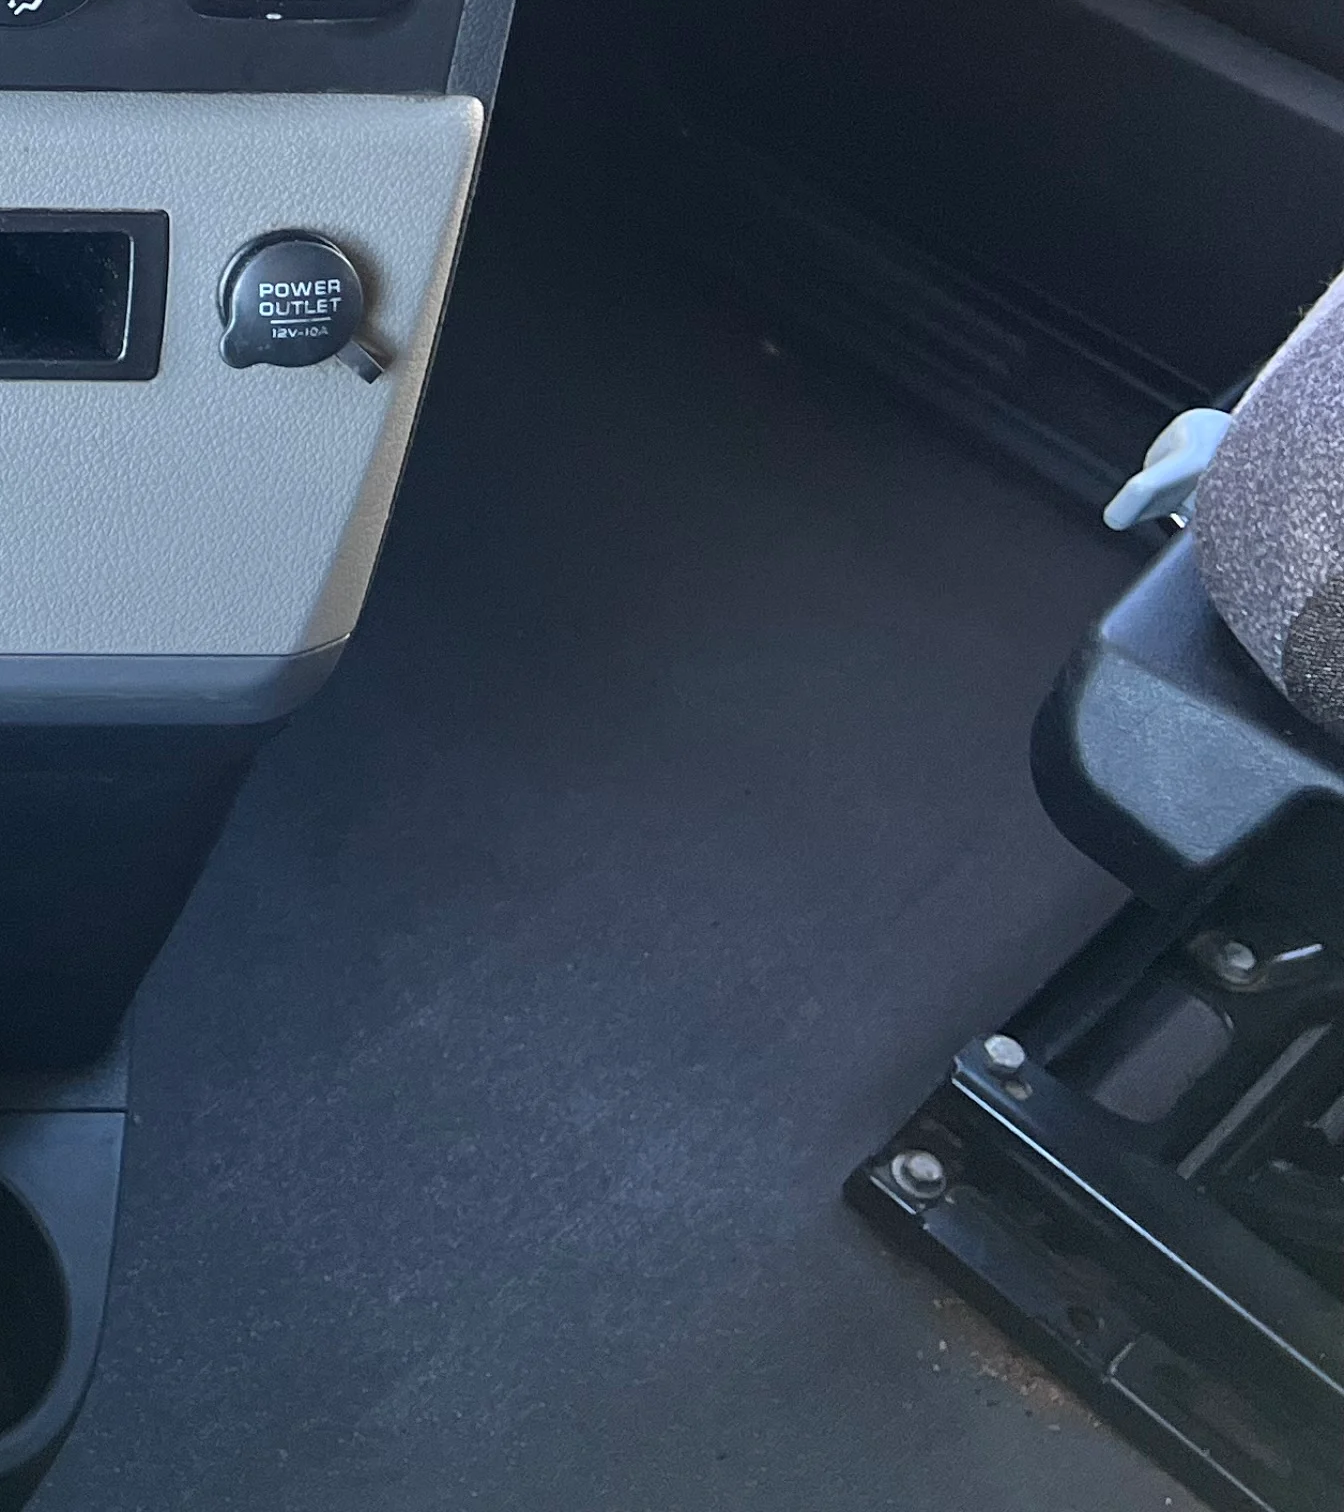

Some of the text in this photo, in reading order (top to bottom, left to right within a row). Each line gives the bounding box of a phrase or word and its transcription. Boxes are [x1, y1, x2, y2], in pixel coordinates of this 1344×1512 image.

[258, 279, 341, 298] POWER
[258, 298, 342, 317] OUTLET
[272, 326, 329, 339] 12V-10A
